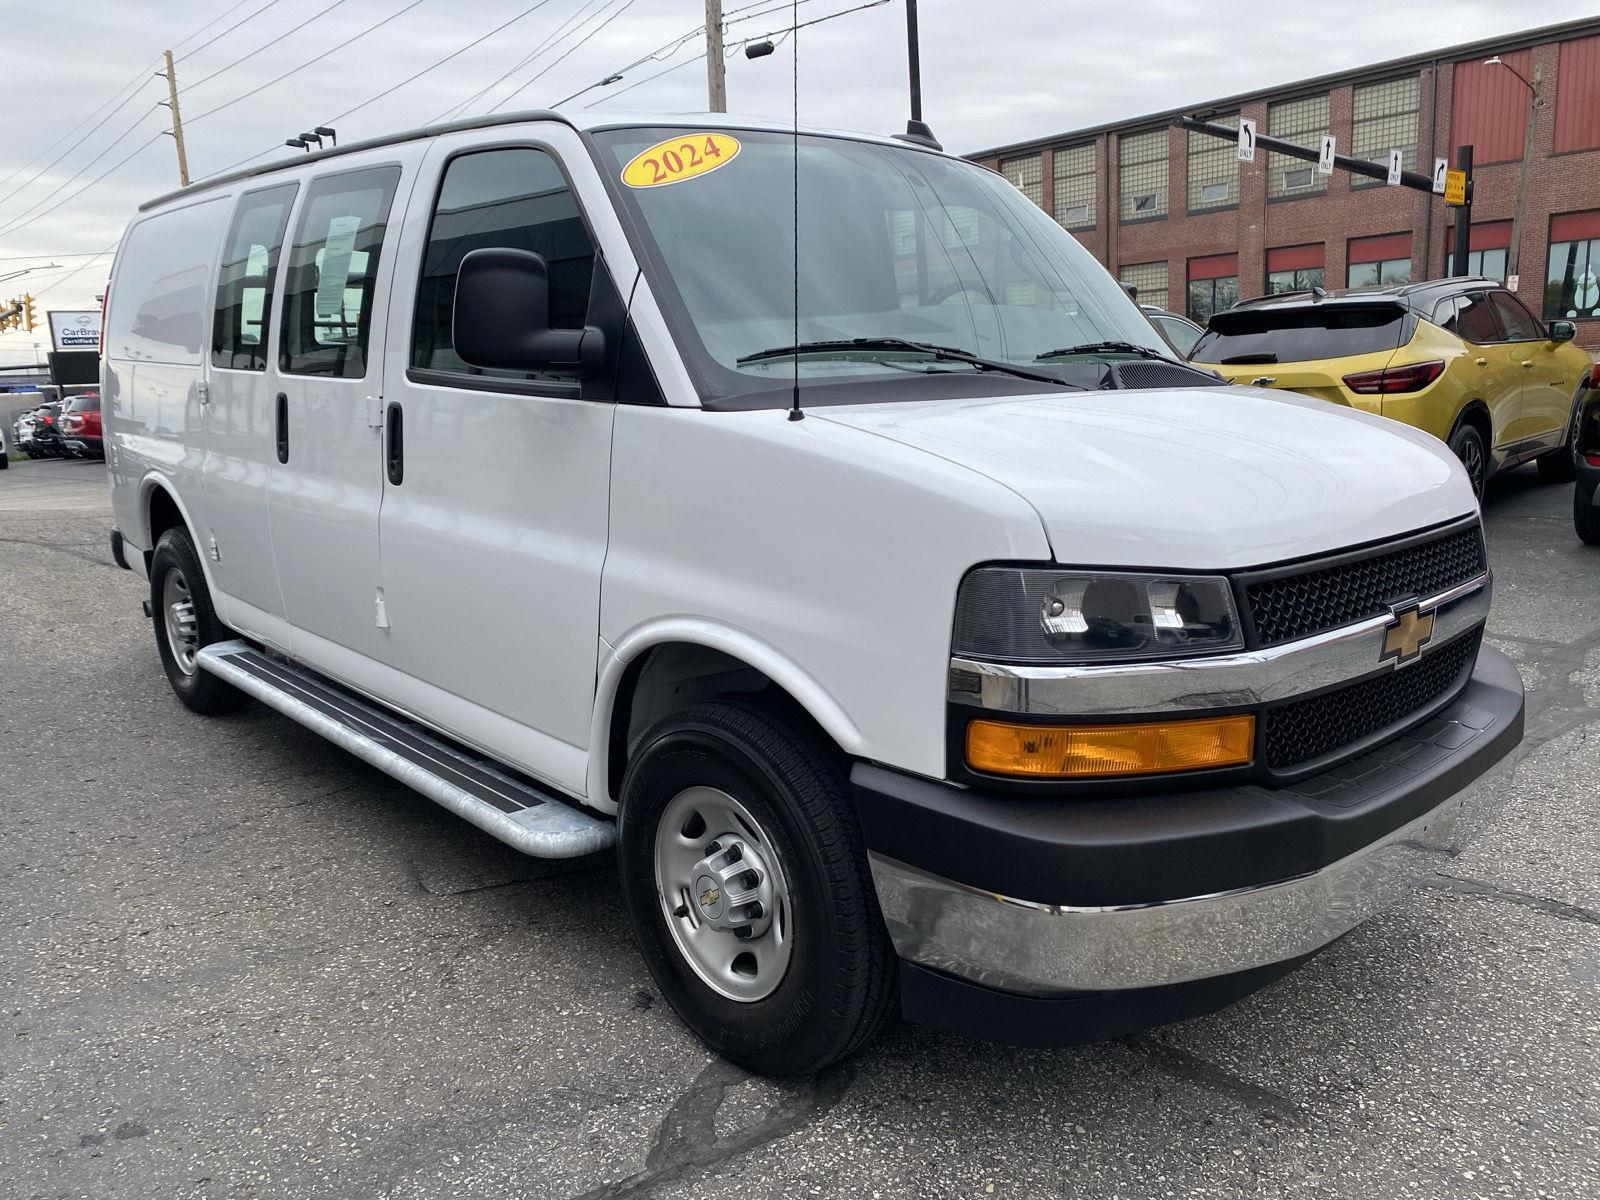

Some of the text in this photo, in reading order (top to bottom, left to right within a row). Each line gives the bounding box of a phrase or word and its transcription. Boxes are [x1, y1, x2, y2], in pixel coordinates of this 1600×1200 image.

[1240, 148, 1253, 158] ONLY
[643, 136, 720, 183] 2024
[1321, 161, 1332, 169] ONLY
[1390, 173, 1399, 181] ONLY
[1434, 182, 1444, 190] ONLY
